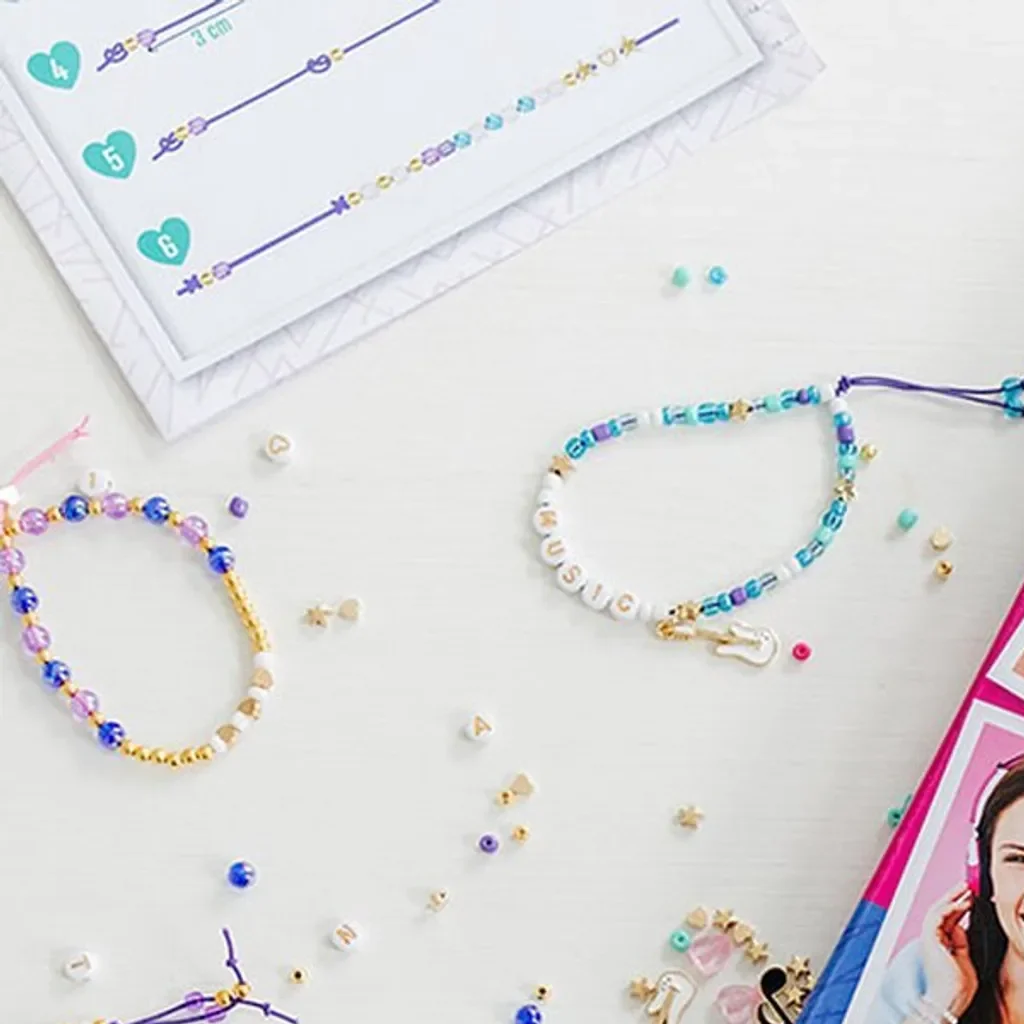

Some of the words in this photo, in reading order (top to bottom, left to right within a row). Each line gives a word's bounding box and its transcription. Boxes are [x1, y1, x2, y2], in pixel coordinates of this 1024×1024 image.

[189, 28, 207, 48] 3
[206, 15, 234, 40] cm
[49, 57, 70, 81] 4
[101, 145, 126, 173] 5
[157, 232, 179, 260] 6
